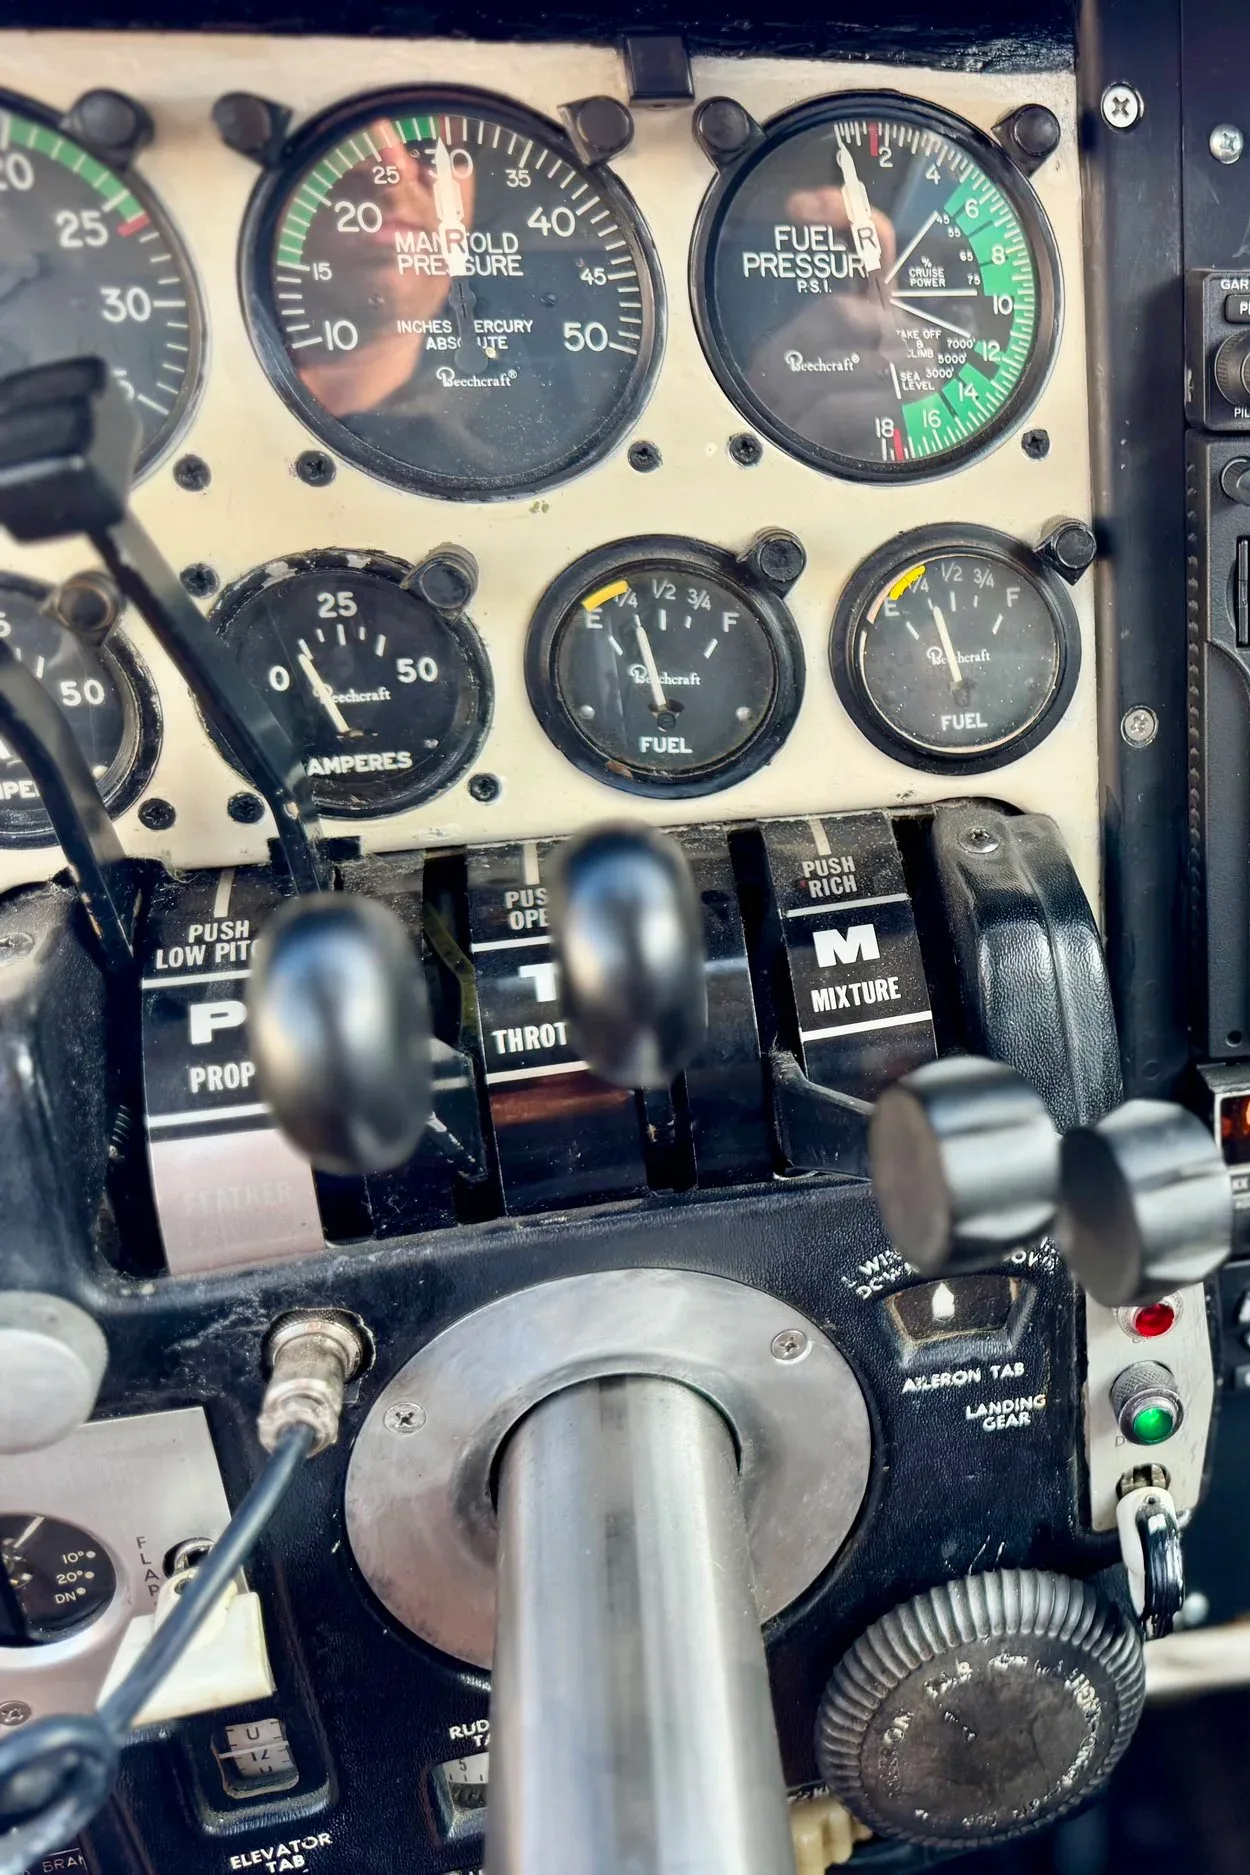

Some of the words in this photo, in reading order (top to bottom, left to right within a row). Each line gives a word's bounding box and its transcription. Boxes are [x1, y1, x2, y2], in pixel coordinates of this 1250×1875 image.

[878, 147, 893, 167] 2
[372, 167, 400, 184] 25
[506, 170, 531, 187] 35
[925, 163, 940, 184] 4
[335, 202, 382, 232] 20
[965, 198, 979, 218] 6
[56, 211, 108, 247] 25
[527, 207, 575, 237] 40
[936, 215, 950, 225] 45
[774, 225, 847, 251] FUEL
[857, 227, 877, 251] R
[948, 228, 961, 238] 55
[742, 252, 869, 278] PRESSUR
[959, 251, 973, 262] 65
[992, 245, 1005, 265] 8
[312, 263, 332, 280] 15
[581, 268, 607, 286] 45
[909, 268, 945, 278] CRUISE
[967, 275, 981, 285] 75
[910, 278, 946, 288] POWER
[101, 287, 151, 321] 30
[993, 293, 1012, 315] 10
[325, 321, 357, 351] 10
[397, 320, 453, 334] INCHES
[474, 320, 533, 333] ERCURY
[564, 323, 608, 352] 50
[923, 329, 942, 339] OFF
[426, 336, 508, 350] ABSUTE
[983, 340, 1000, 362] 12
[900, 372, 921, 382] SEA
[902, 381, 935, 391] LEVEL
[959, 382, 978, 402] 14
[876, 418, 894, 438] 18
[923, 408, 941, 428] 16
[941, 560, 963, 582] 1/2
[973, 568, 995, 589] 3/4
[652, 579, 676, 600] 1/2
[687, 588, 712, 611] 3/4
[1006, 587, 1021, 608] F
[317, 591, 358, 618] 25
[884, 598, 900, 617] E
[585, 608, 603, 629] E
[722, 612, 742, 632] F
[269, 666, 290, 691] 0
[396, 657, 438, 683] 50
[60, 679, 105, 706] 50
[941, 712, 988, 731] FUEL
[639, 737, 693, 754] FUEL
[307, 751, 413, 776] AMPERES
[801, 855, 856, 879] PUSH
[808, 874, 858, 899] RICH
[504, 887, 549, 909] PUS
[509, 907, 550, 930] OPE
[188, 920, 250, 943] PUSH
[812, 922, 881, 969] M
[156, 944, 206, 970] LOW
[810, 976, 902, 1014] MIXTURE
[190, 1000, 249, 1045] P
[490, 1021, 567, 1055] THROT
[190, 1061, 255, 1093] PROP
[902, 1367, 982, 1394] AILERON
[990, 1362, 1025, 1380] TAB
[966, 1393, 1046, 1420] LANDING
[982, 1411, 1031, 1432] GEAR
[55, 1591, 77, 1605] DN
[449, 1719, 491, 1740] RUD
[459, 1759, 467, 1771] 5
[230, 1832, 333, 1870] ELEVATOR
[266, 1854, 306, 1873] TAB
